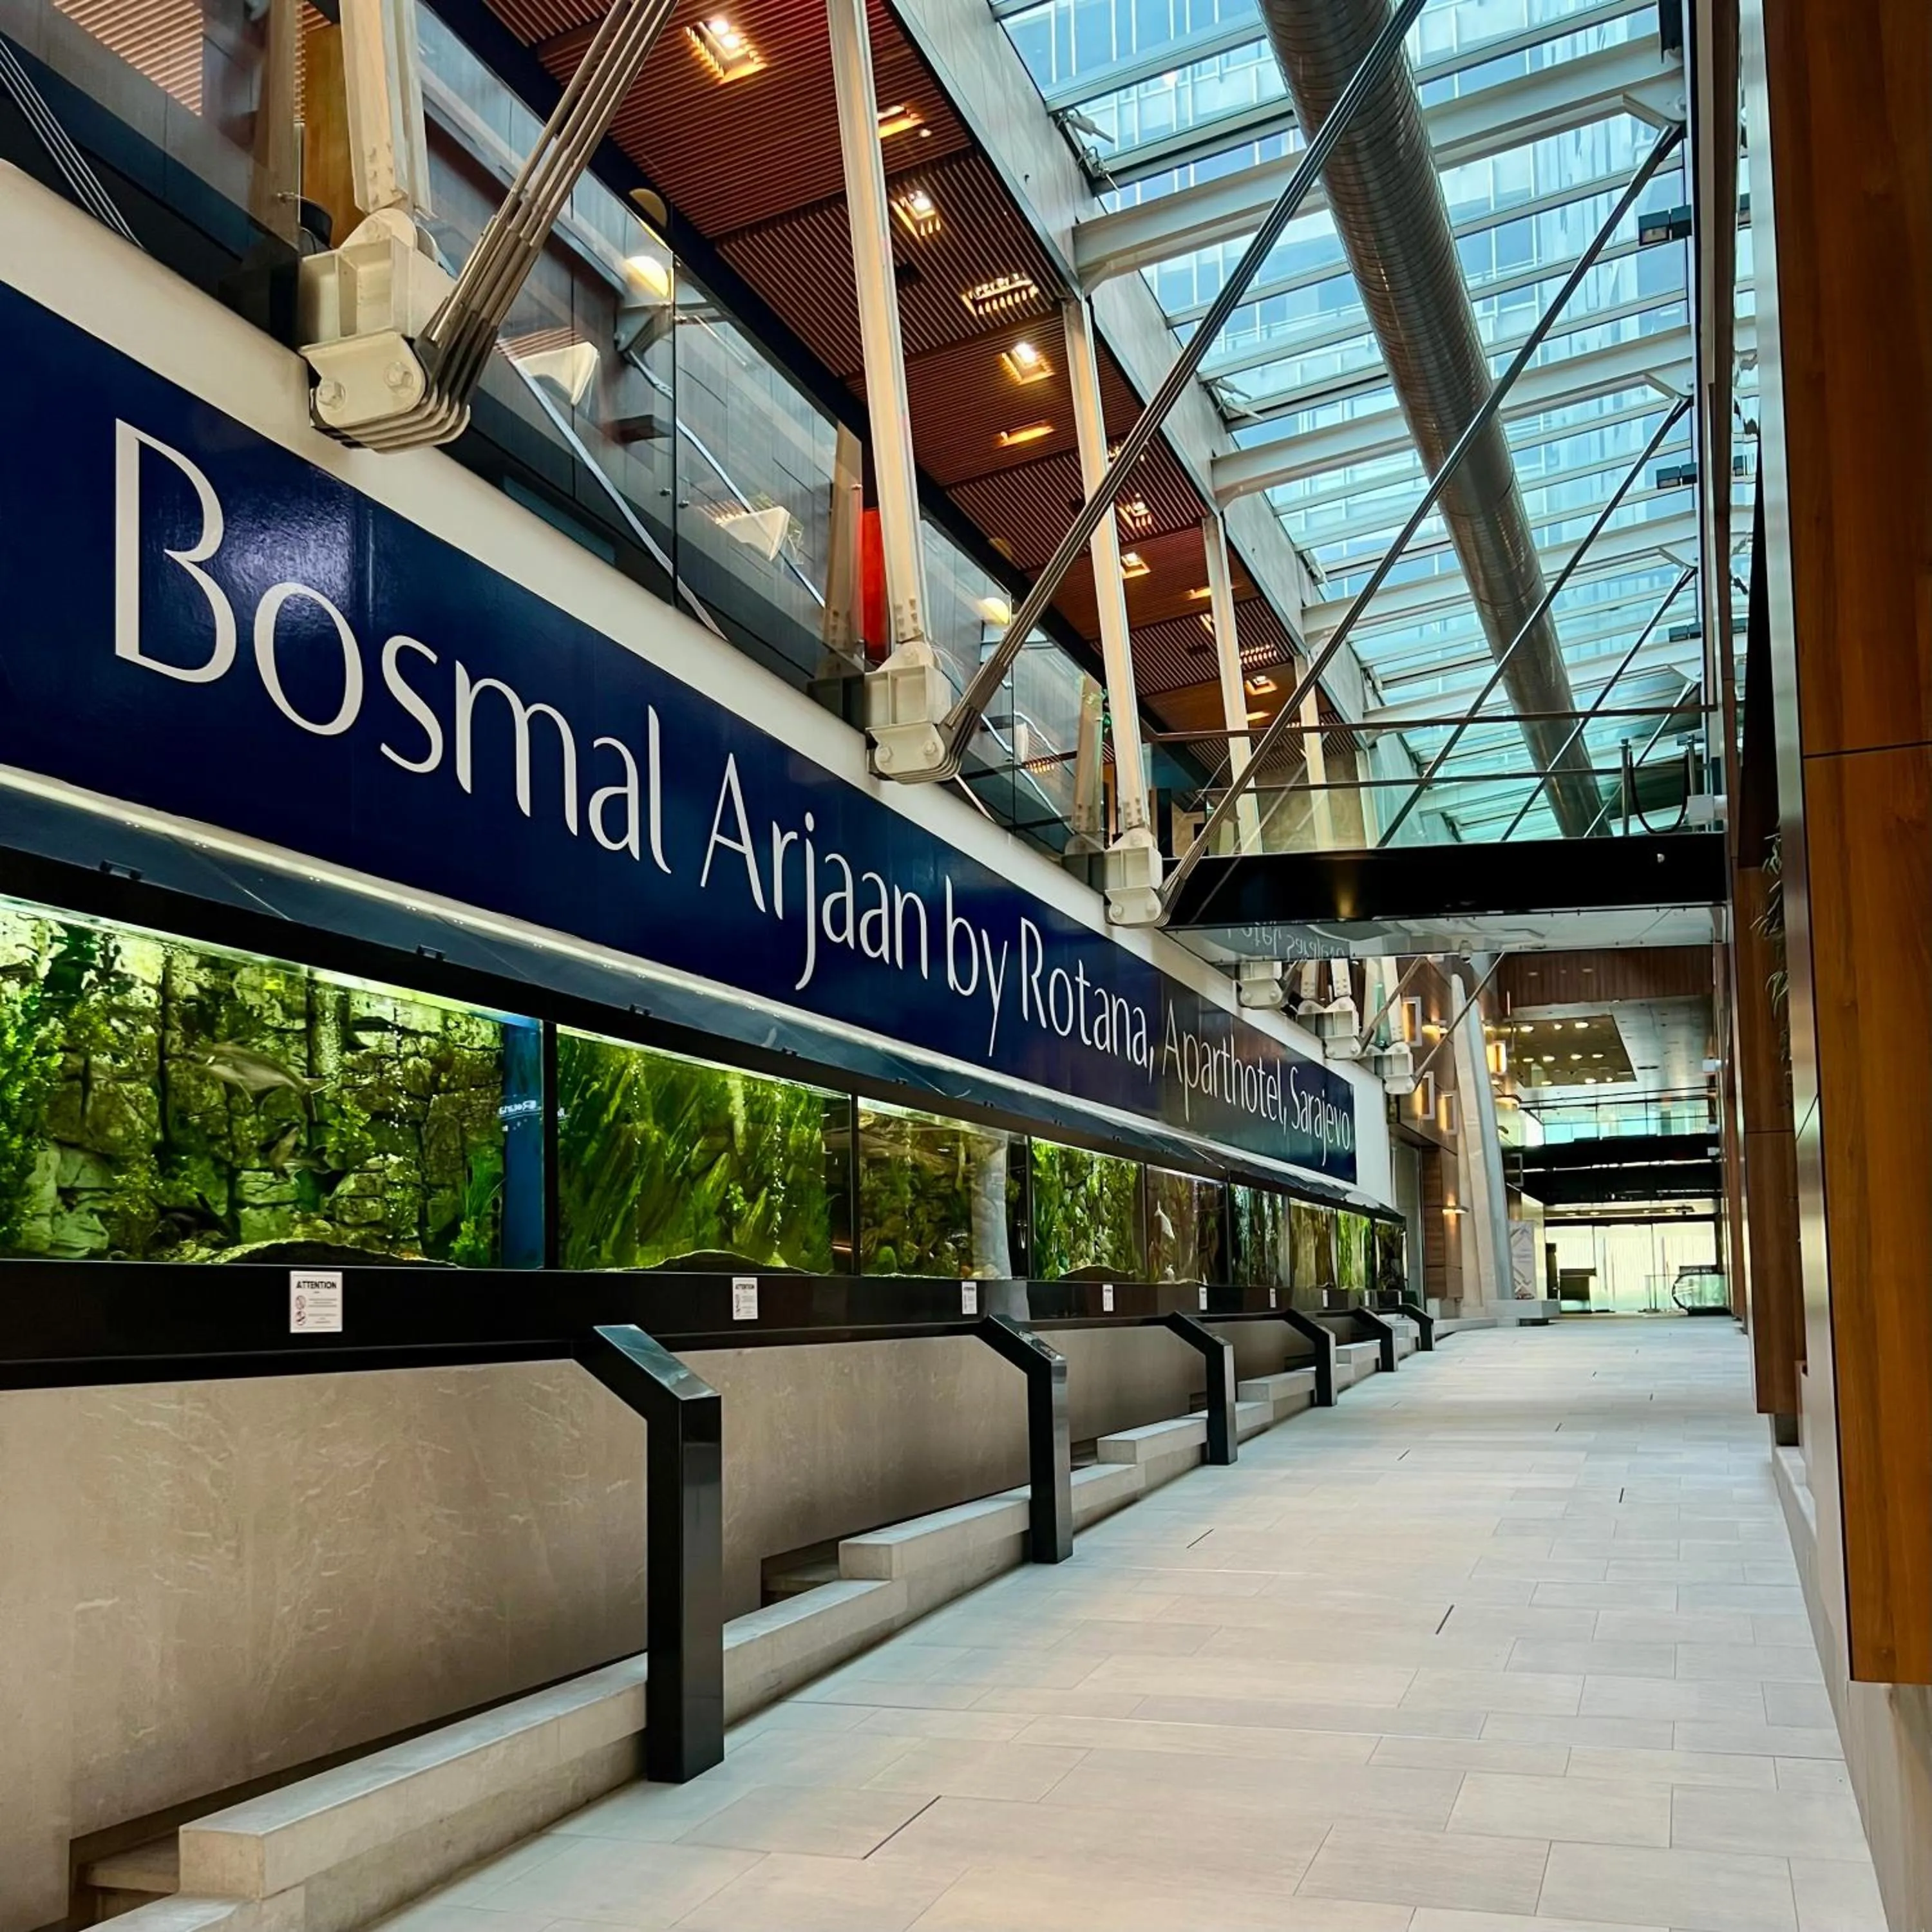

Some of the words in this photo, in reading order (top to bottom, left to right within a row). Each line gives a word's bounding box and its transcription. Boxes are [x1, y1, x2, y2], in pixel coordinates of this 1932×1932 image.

[115, 417, 672, 875] Bosmal
[700, 752, 928, 991] Arjaan
[946, 875, 1008, 1057] by
[1021, 916, 1155, 1084] Rotana,
[1162, 999, 1287, 1134] Aparthotel,
[1289, 1066, 1350, 1166] Sarajevo
